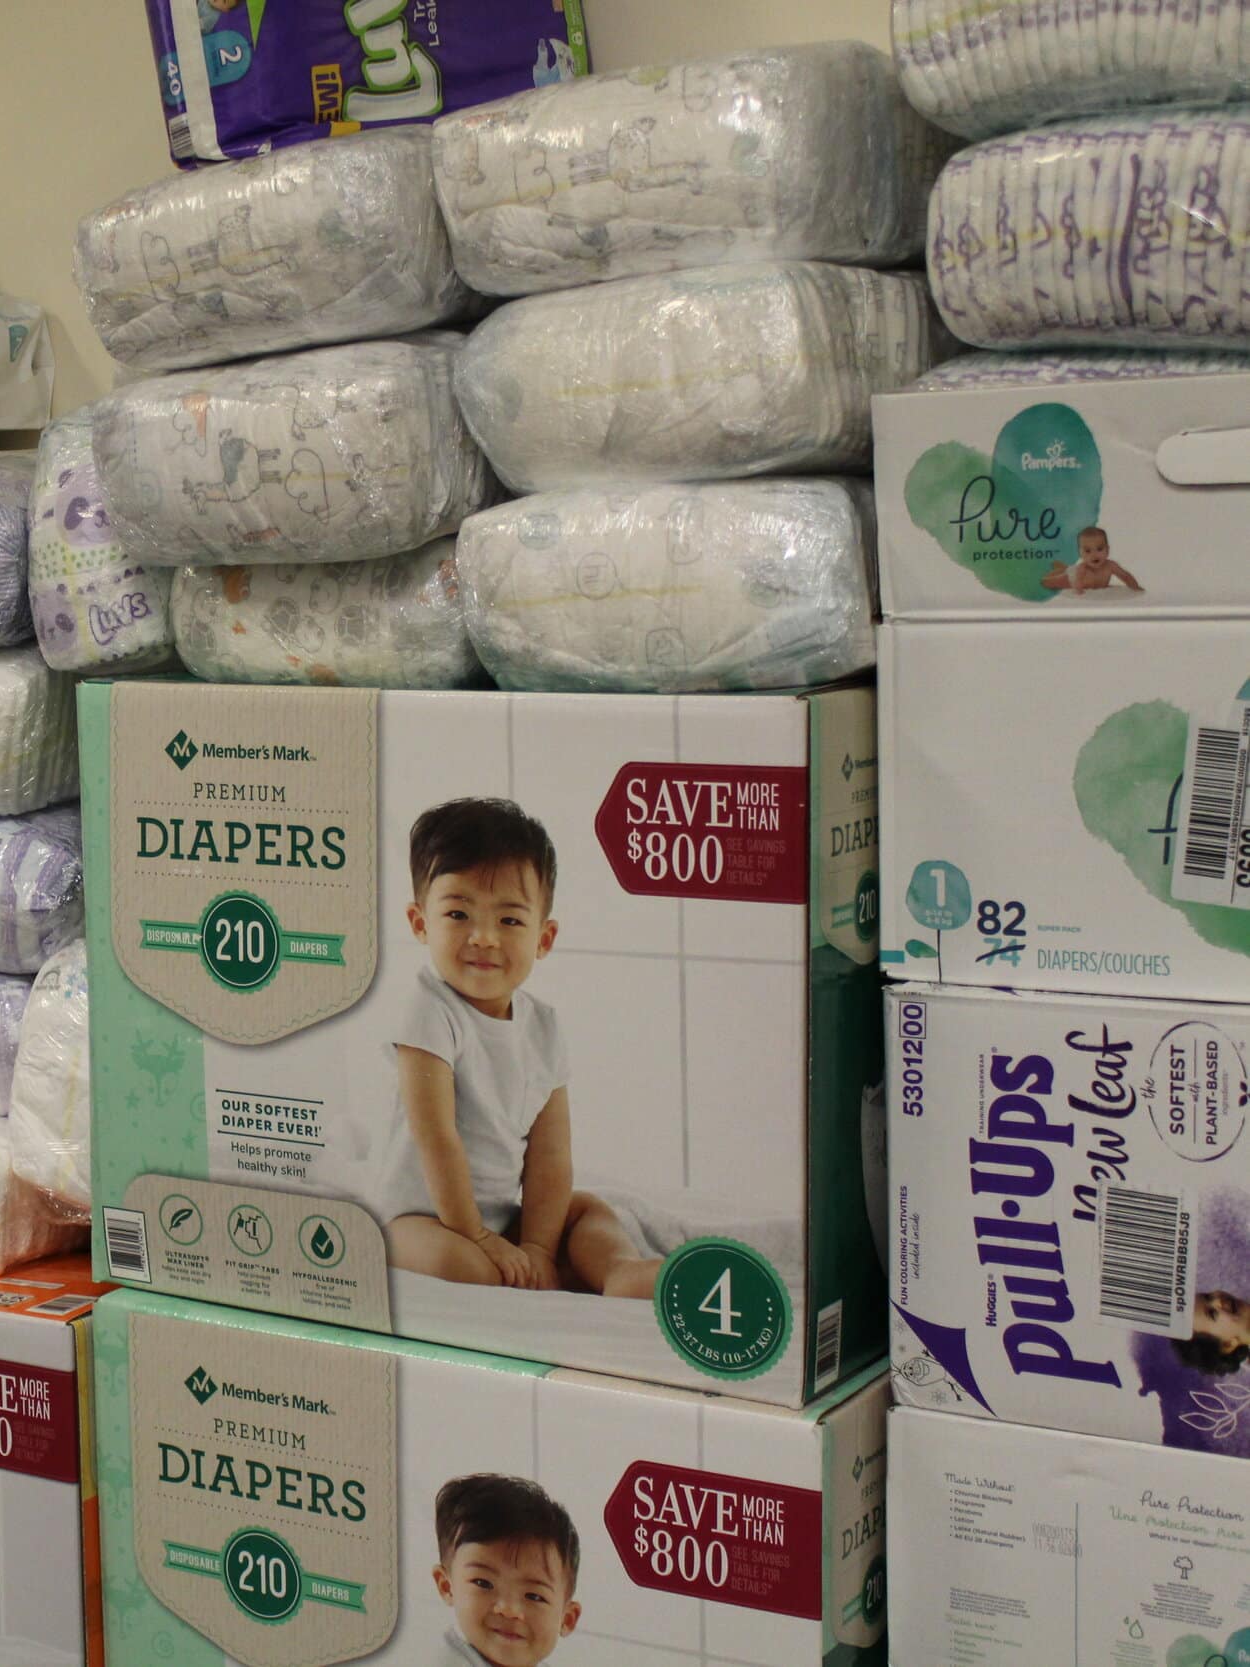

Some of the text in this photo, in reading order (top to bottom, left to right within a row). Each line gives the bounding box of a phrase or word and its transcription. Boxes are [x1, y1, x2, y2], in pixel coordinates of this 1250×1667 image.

[219, 45, 243, 67] 2
[1021, 452, 1077, 472] Pampers
[950, 475, 1062, 543] Pure
[202, 742, 310, 762] Member's Mark
[193, 782, 286, 803] PREMIUM
[626, 777, 734, 828] SAVE
[736, 782, 779, 807] MORE
[739, 806, 780, 831] THAN
[136, 816, 347, 871] DIAPERS
[627, 827, 724, 884] $800
[930, 868, 947, 908] 1
[977, 899, 1027, 937] 82
[215, 918, 264, 964] 210
[290, 941, 328, 956] DIAPERS
[1037, 948, 1171, 977] DIAPERS/COUCHES
[1065, 1024, 1135, 1118] leaf
[1140, 1077, 1156, 1099] the
[1169, 1044, 1186, 1135] SOFTEST
[1206, 1041, 1219, 1146] PLANT-BASED
[221, 1099, 318, 1122] OUR SOFTEST
[221, 1115, 273, 1132] DIAPER
[231, 1141, 312, 1163] Helps promote
[237, 1158, 307, 1178] healthy skin!
[899, 1185, 908, 1305] FUN COLORING ACTIVITIES
[698, 1267, 742, 1338] 4
[985, 1280, 997, 1327] HUGGIES
[672, 1312, 698, 1347] 22-37
[697, 1343, 720, 1362] LBS
[757, 1327, 773, 1350] KG)
[19, 1377, 50, 1401] MORE
[222, 1382, 329, 1415] Member's Mark
[21, 1397, 51, 1421] THAN
[213, 1418, 307, 1450] PREMIUM
[157, 1441, 367, 1522] DIAPERS
[944, 1472, 972, 1486] Made
[634, 1475, 738, 1537] SAVE
[742, 1494, 785, 1524] MORE
[1178, 1495, 1245, 1523] Protection
[742, 1517, 785, 1547] THAN
[634, 1523, 729, 1588] $800
[238, 1550, 287, 1599] 210
[311, 1582, 350, 1601] DIAPERS
